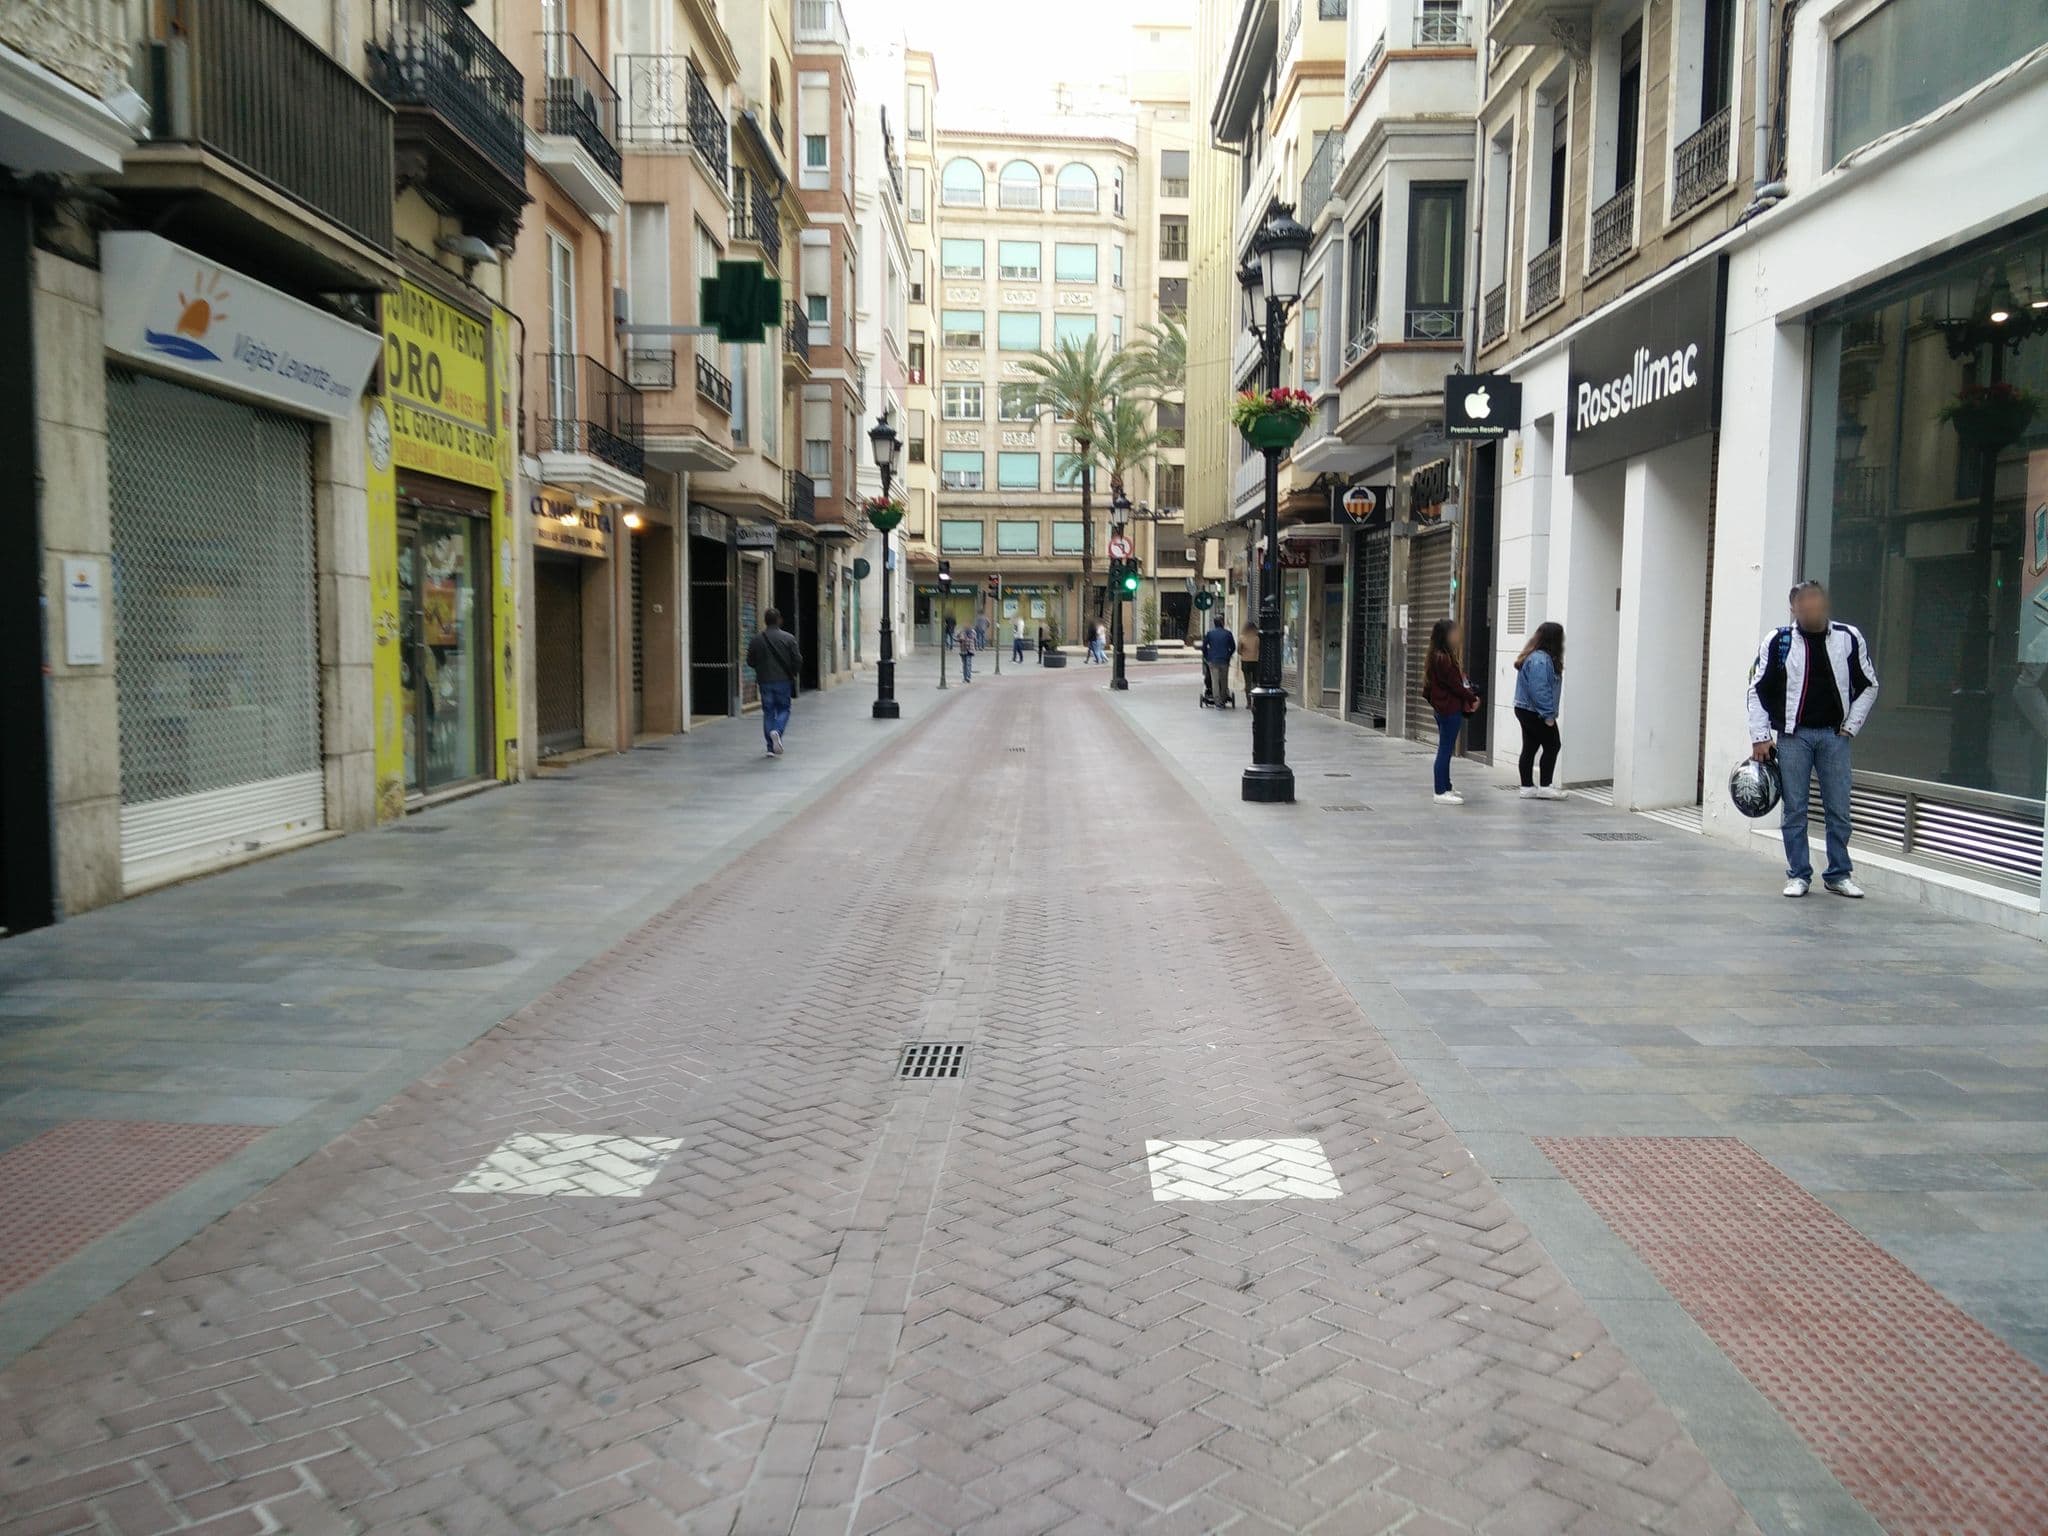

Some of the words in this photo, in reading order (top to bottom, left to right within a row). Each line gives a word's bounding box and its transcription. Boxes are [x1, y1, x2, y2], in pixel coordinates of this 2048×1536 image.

[233, 333, 278, 372] Viajes
[279, 351, 330, 390] Levante
[438, 305, 446, 343] Y
[448, 311, 484, 364] VENDO
[388, 332, 442, 403] ORO
[1577, 343, 1698, 431] Rossellimac
[393, 402, 408, 434] EL
[413, 410, 452, 449] GORDO
[456, 425, 471, 455] DE
[473, 431, 494, 462] ORO
[1450, 426, 1479, 434] Premium
[1479, 425, 1504, 434] Reseller
